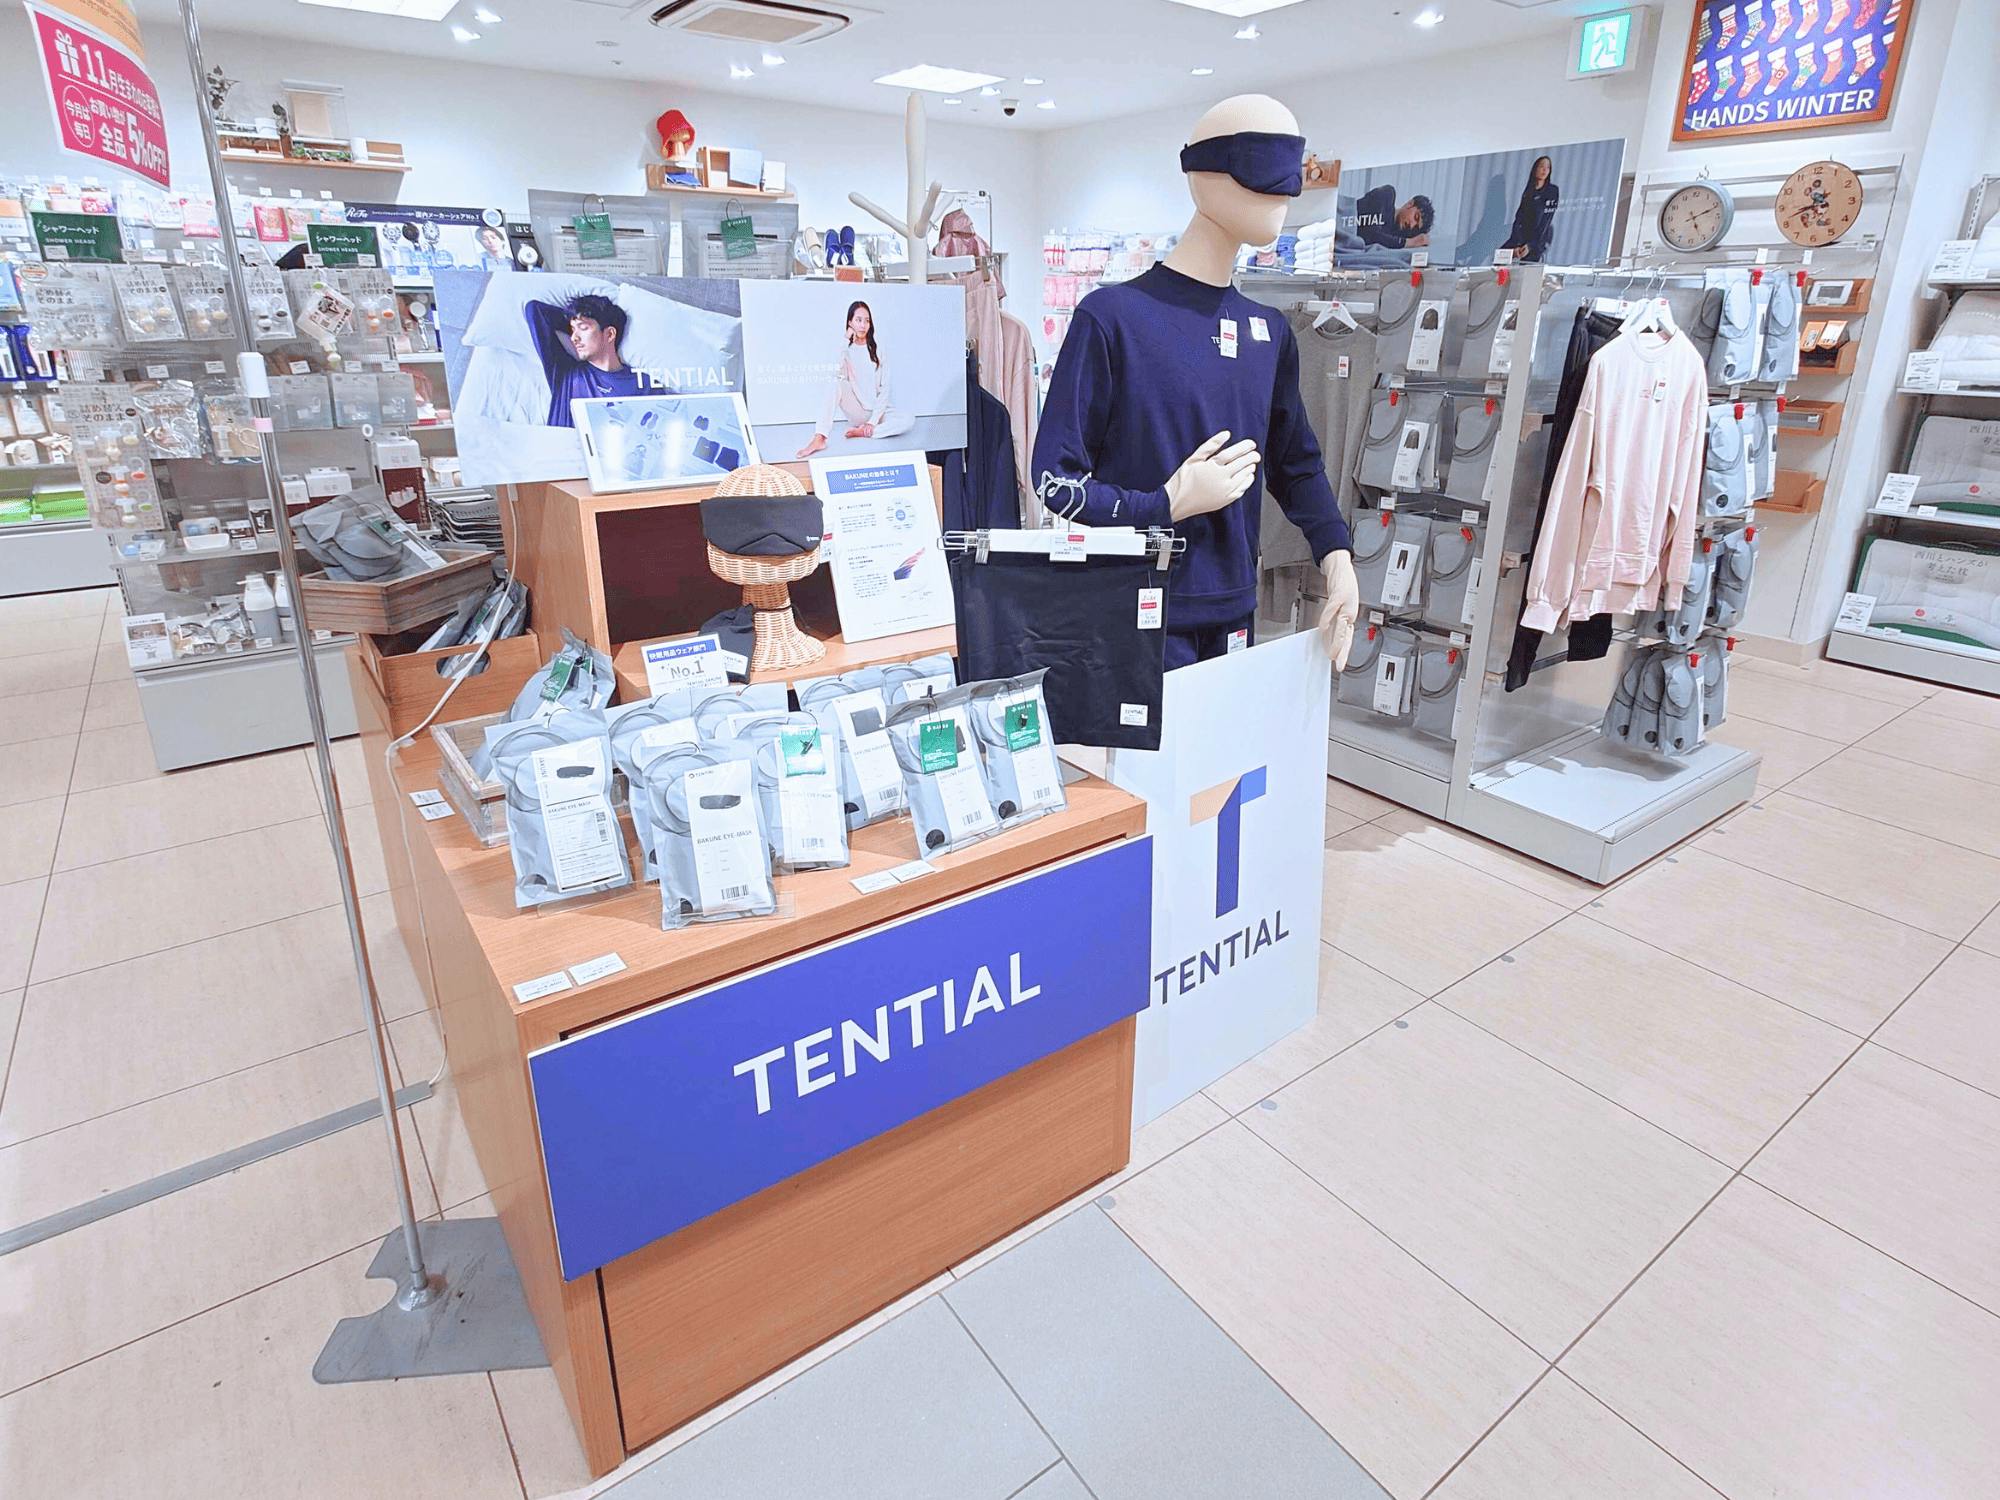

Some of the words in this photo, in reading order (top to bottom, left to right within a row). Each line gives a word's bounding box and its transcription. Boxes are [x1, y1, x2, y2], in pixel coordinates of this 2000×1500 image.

[1691, 103, 1769, 130] HANDS
[1776, 88, 1875, 119] WINTER
[74, 121, 92, 140] 毎日
[99, 122, 128, 160] 全品
[1813, 166, 1824, 175] 12
[1844, 180, 1852, 189] 2
[1783, 187, 1793, 196] 10
[1847, 196, 1856, 205] 3
[1778, 204, 1785, 212] 9
[1340, 212, 1385, 228] TENTIAL
[1841, 214, 1849, 222] 4
[42, 224, 100, 235] シャワーヘッド
[1783, 220, 1790, 229] 8
[1793, 231, 1800, 240] 7
[1827, 228, 1836, 237] 5
[315, 235, 363, 245] シャワーヘッド
[1809, 234, 1817, 243] 6
[630, 366, 734, 391] TENTIAL
[670, 659, 705, 680] No.1
[696, 834, 722, 845] BAKUNE
[722, 829, 752, 841] EYE-MASK
[1154, 909, 1290, 1006] TENTIAL
[732, 951, 1042, 1116] TENTIAL
